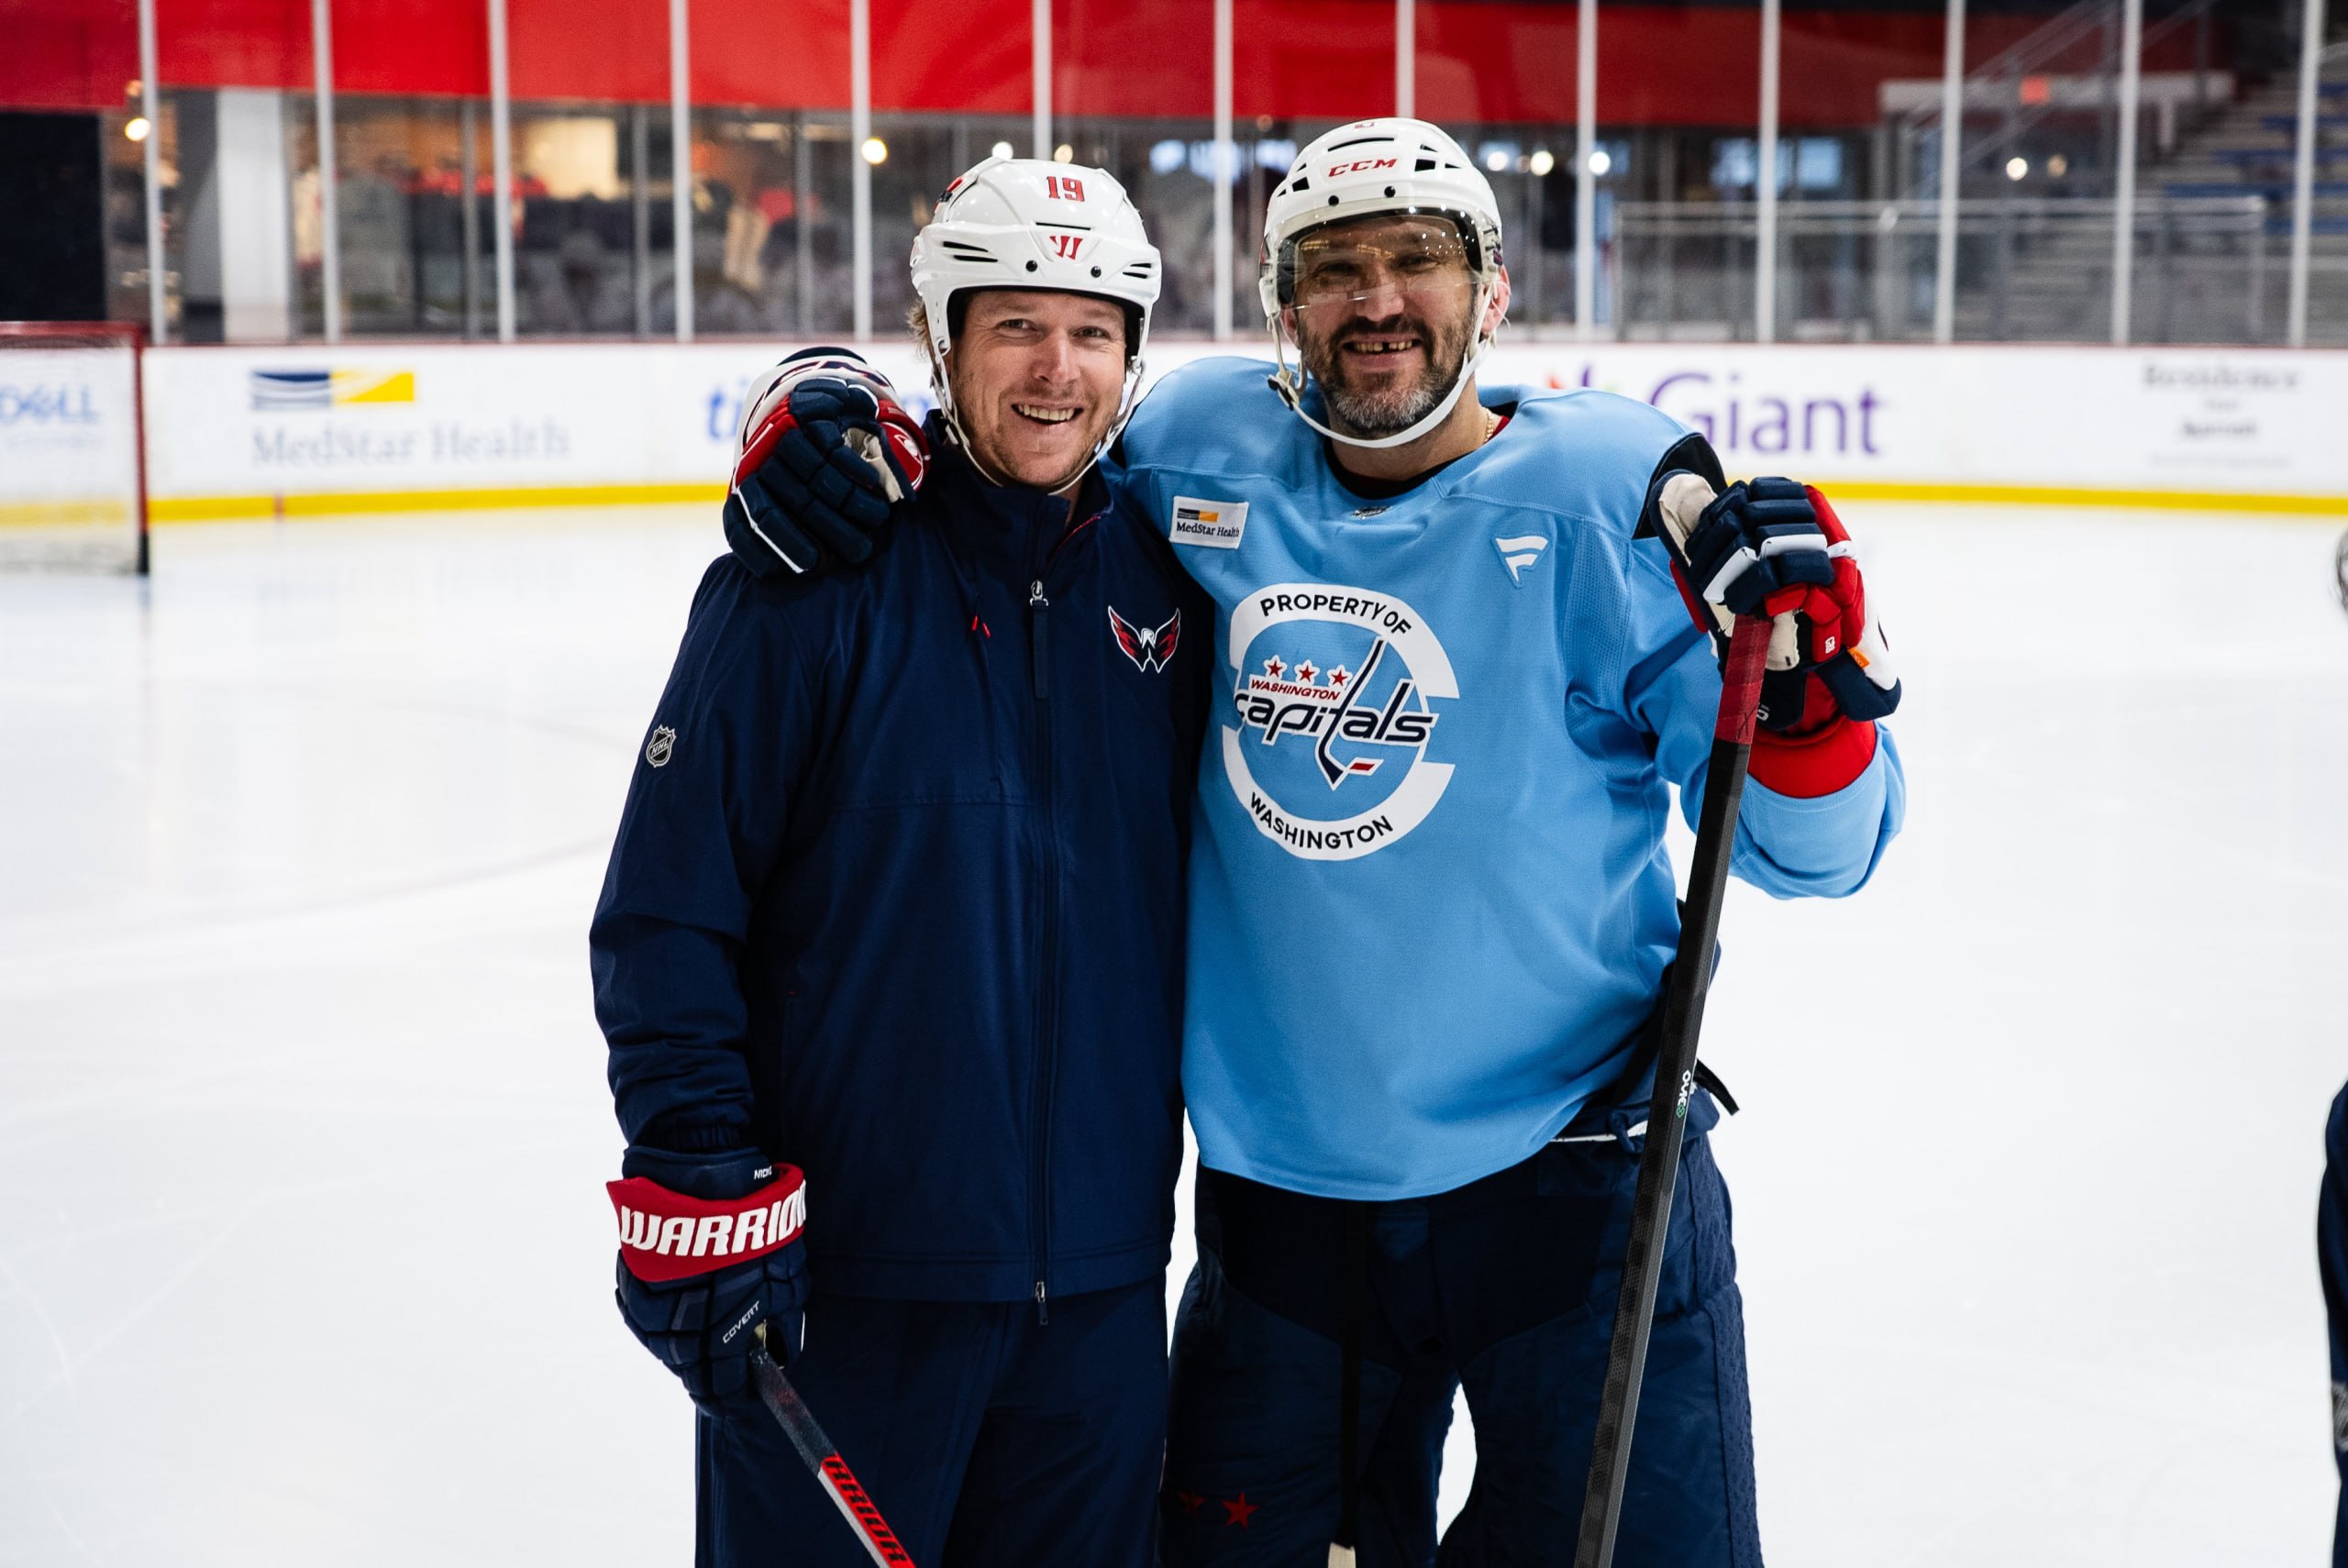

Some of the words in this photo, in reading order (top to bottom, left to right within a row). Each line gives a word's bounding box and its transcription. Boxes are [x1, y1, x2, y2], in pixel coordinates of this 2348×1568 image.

[1328, 159, 1398, 177] CCM
[1047, 176, 1085, 202] 19
[1651, 372, 1884, 454] Giant
[253, 424, 415, 464] MedStar
[431, 416, 570, 460] Health
[1177, 522, 1215, 536] MedStar
[1216, 527, 1239, 537] Health
[1260, 594, 1386, 620] PROPERTY
[1383, 612, 1412, 634] OF
[1251, 679, 1340, 701] WASHINGTON
[651, 738, 669, 756] NHL
[1250, 792, 1393, 849] WASHINGTON
[723, 1300, 759, 1343] COVERT
[825, 1453, 908, 1561] RRIOR
